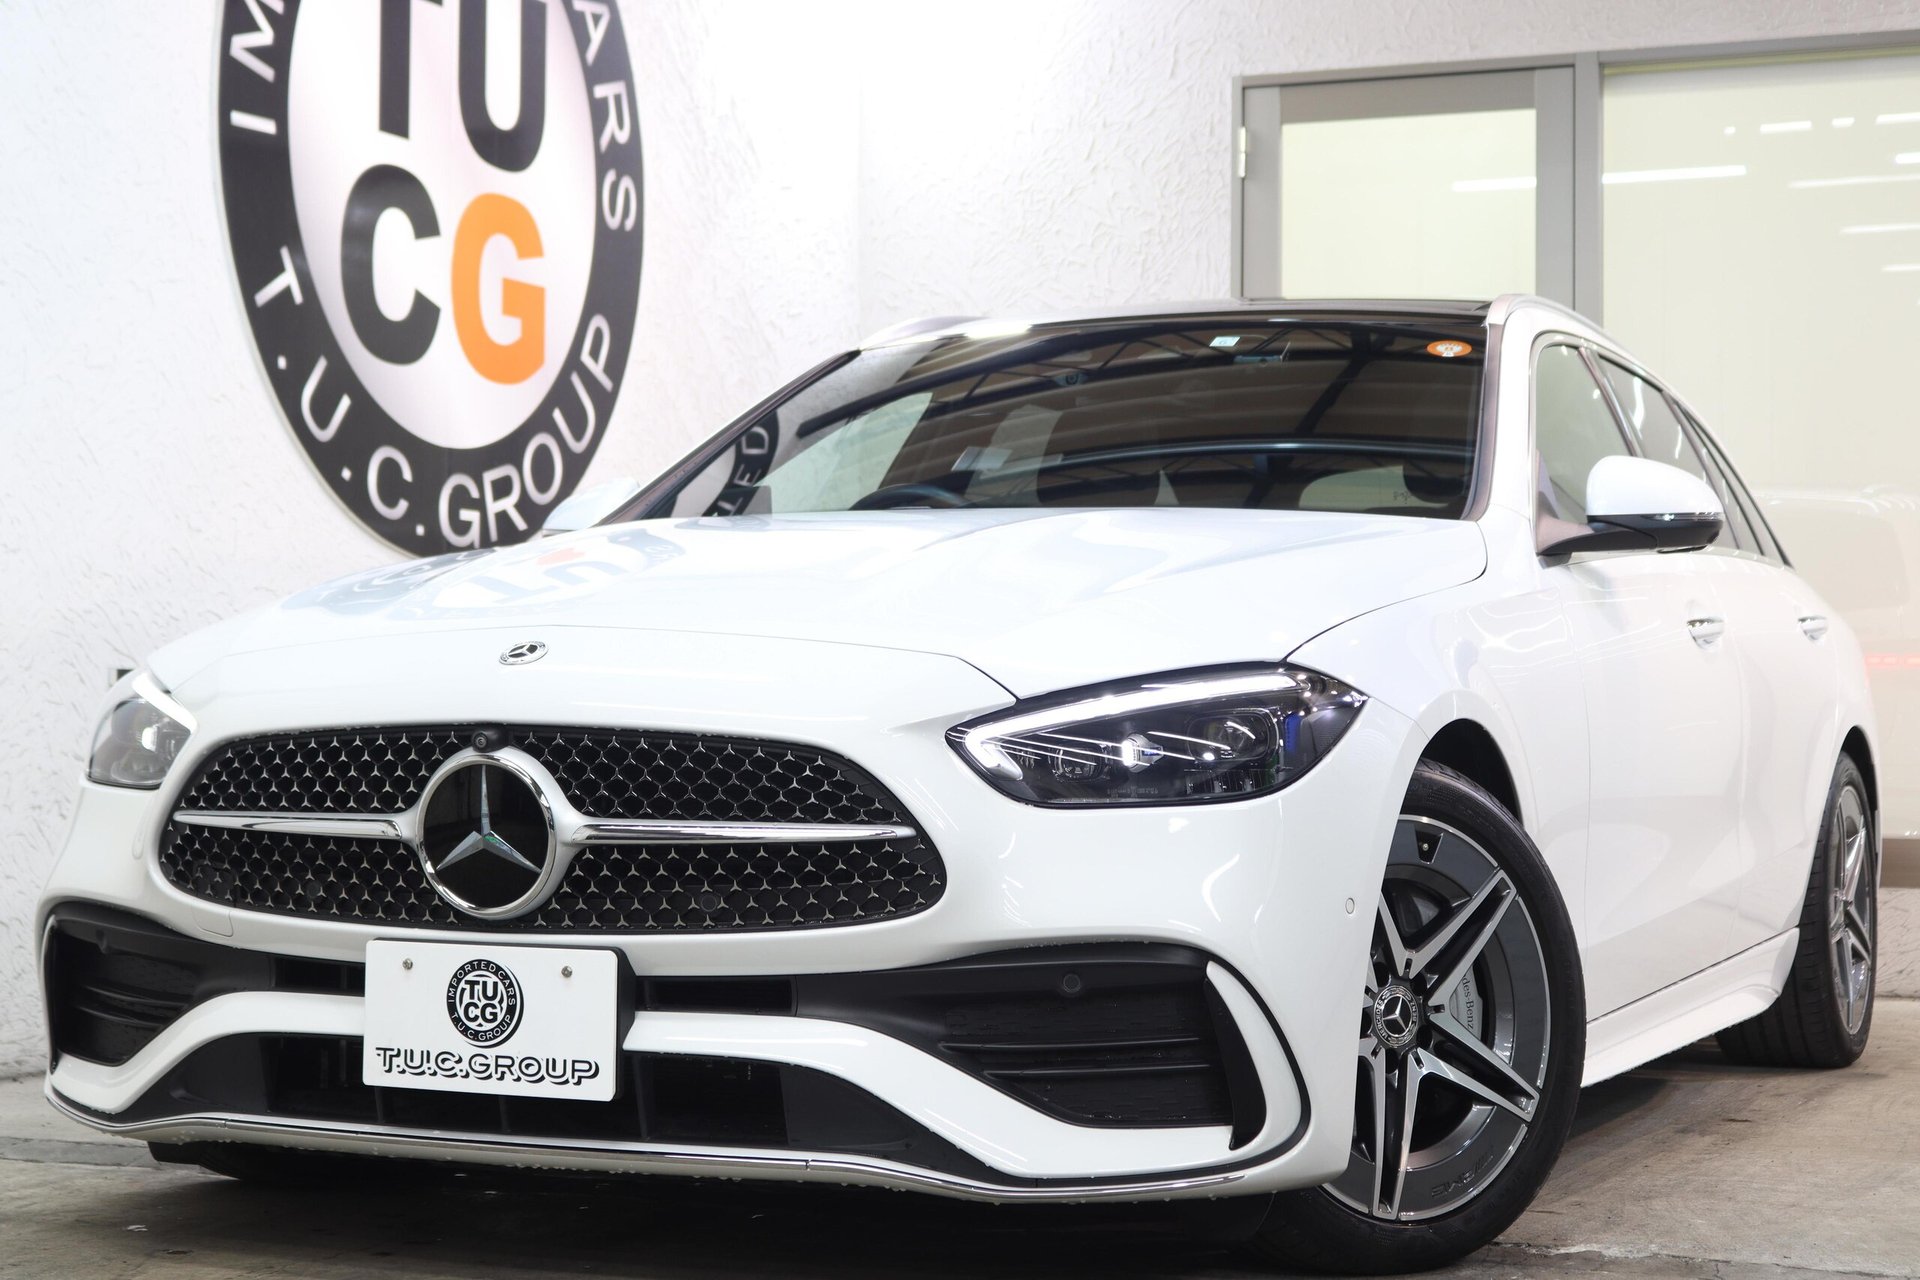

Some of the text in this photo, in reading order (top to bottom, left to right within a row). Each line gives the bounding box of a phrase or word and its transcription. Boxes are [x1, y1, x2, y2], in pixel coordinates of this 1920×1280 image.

[340, 163, 546, 385] CG
[447, 961, 516, 1006] IMPORTED CARS
[464, 979, 499, 1002] TU
[1461, 976, 1475, 1030] des-Benz
[463, 1001, 499, 1024] CG
[375, 1046, 601, 1086] T.U.C.GROUP
